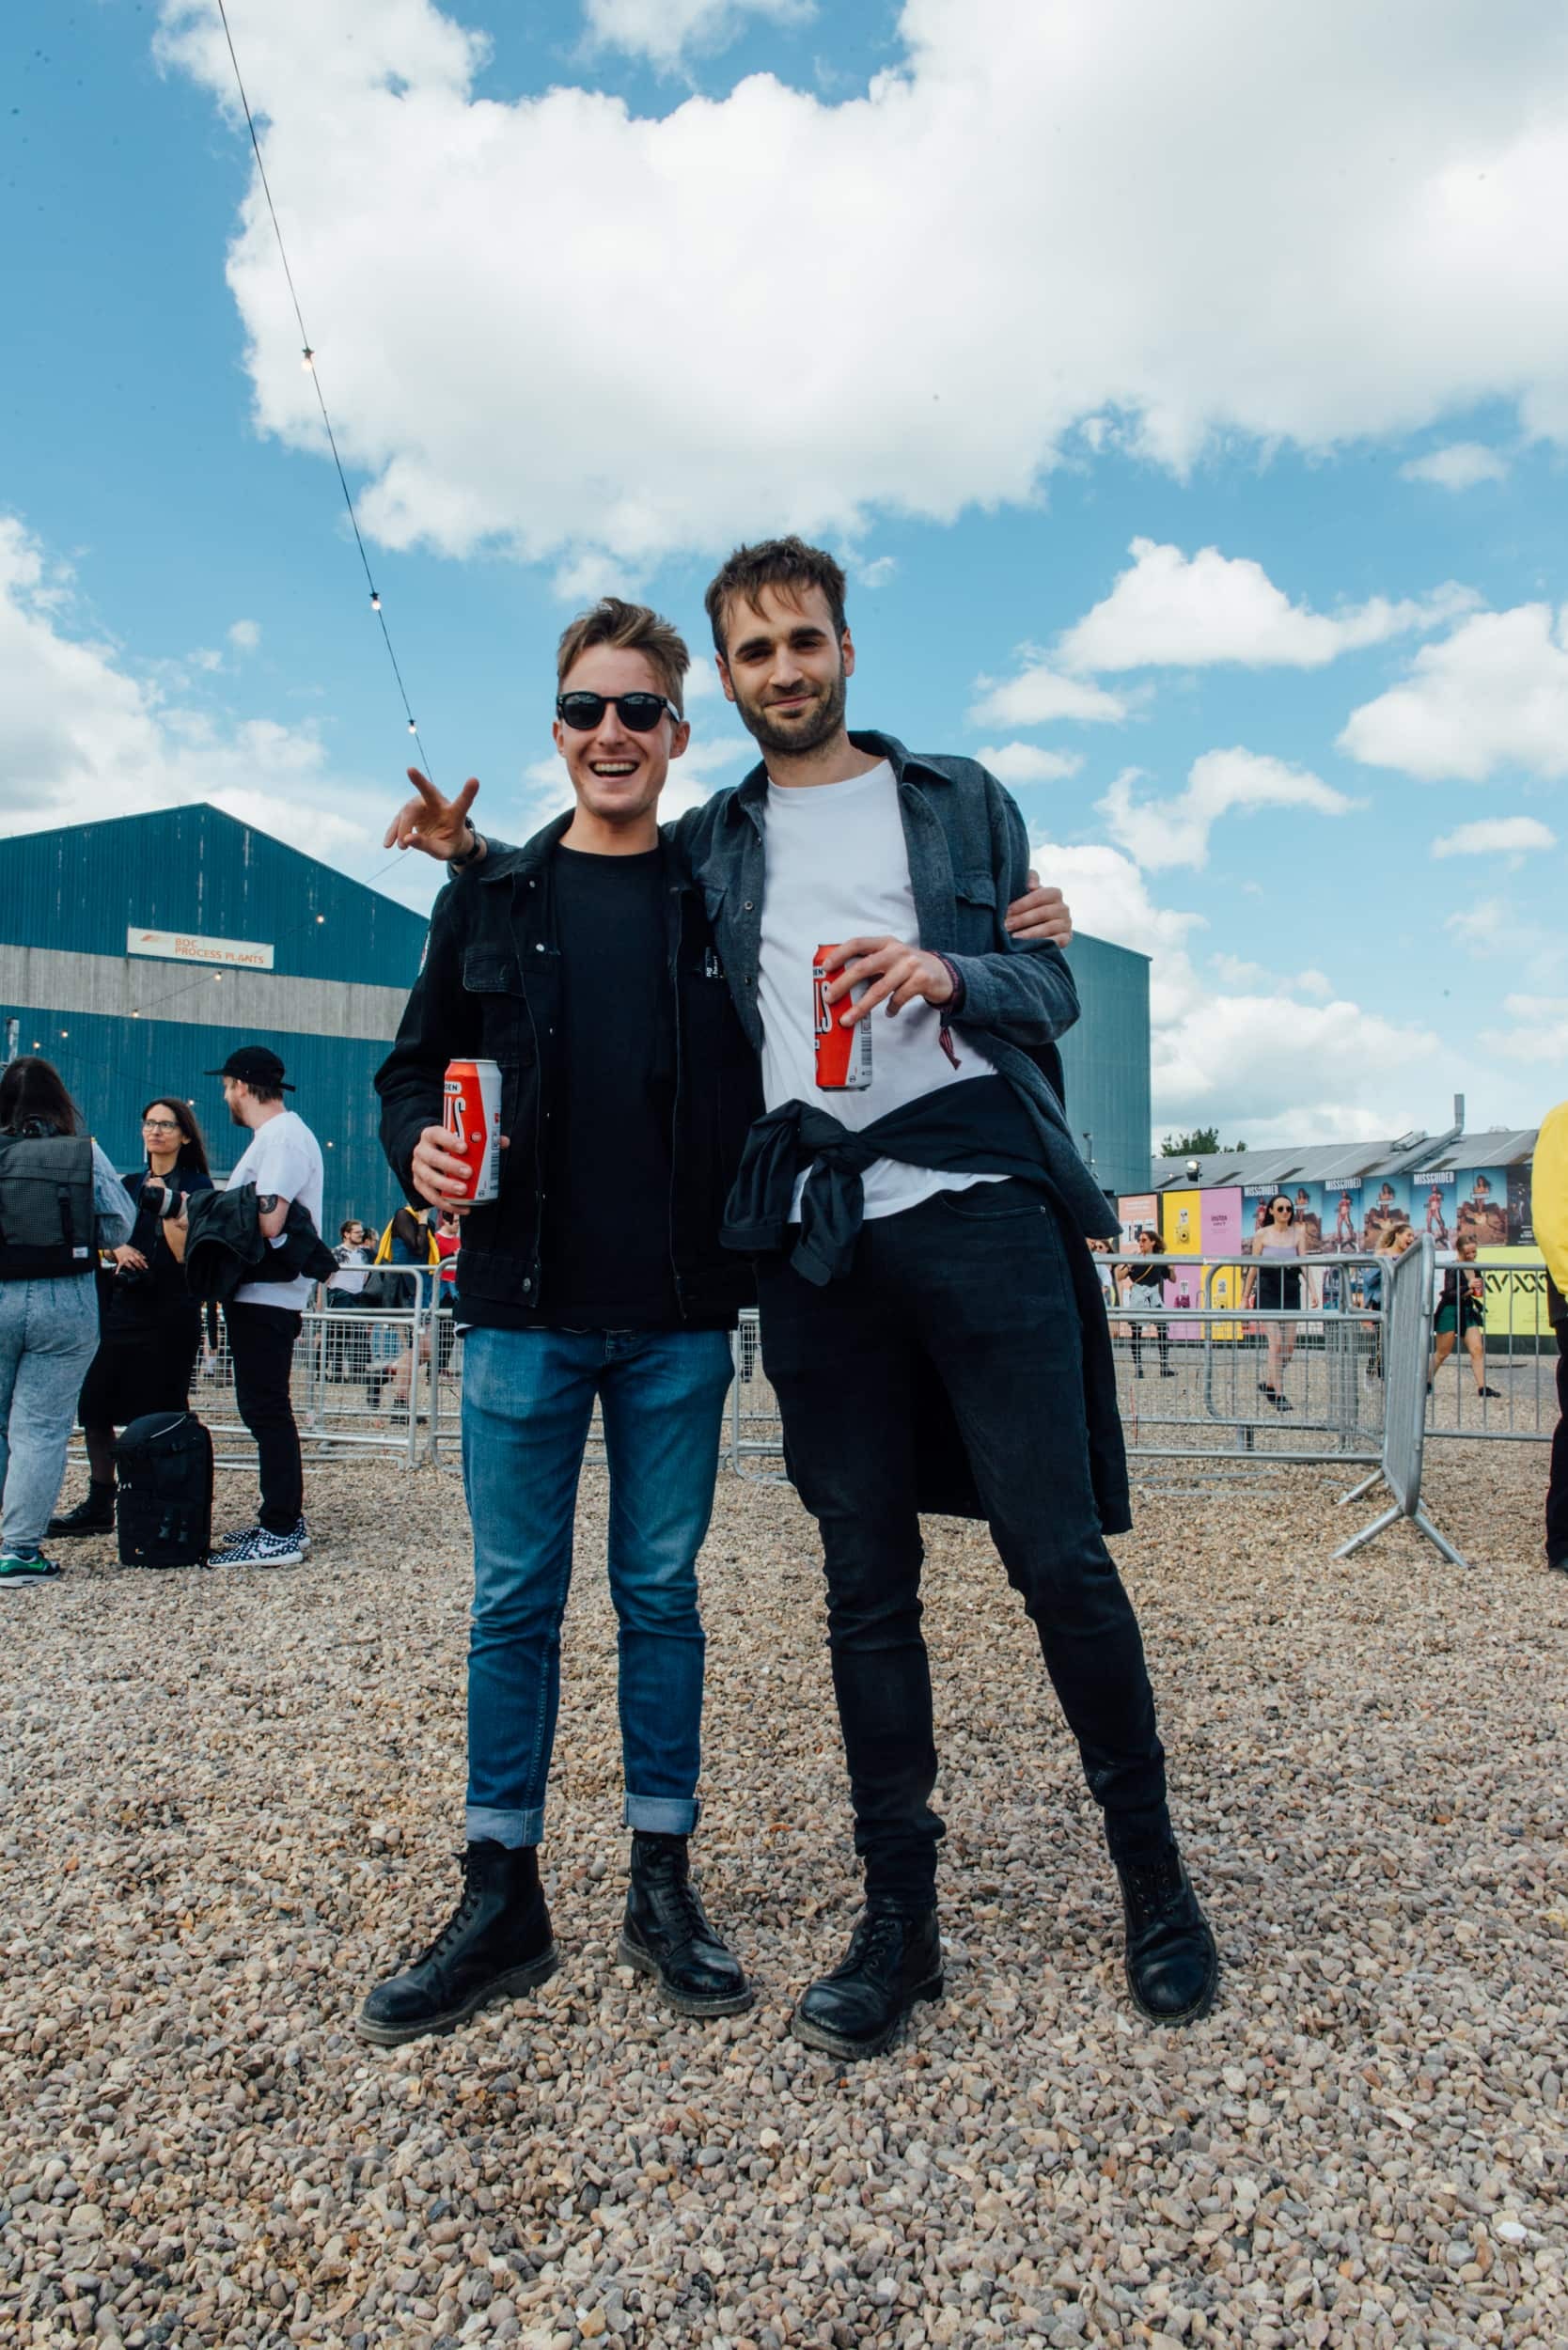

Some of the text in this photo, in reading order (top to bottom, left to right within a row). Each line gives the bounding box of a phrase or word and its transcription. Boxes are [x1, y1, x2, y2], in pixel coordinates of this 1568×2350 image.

[175, 937, 198, 948] BOC
[175, 947, 264, 964] PROCESS PLANTS
[1413, 1171, 1454, 1185] MISSGUIDED
